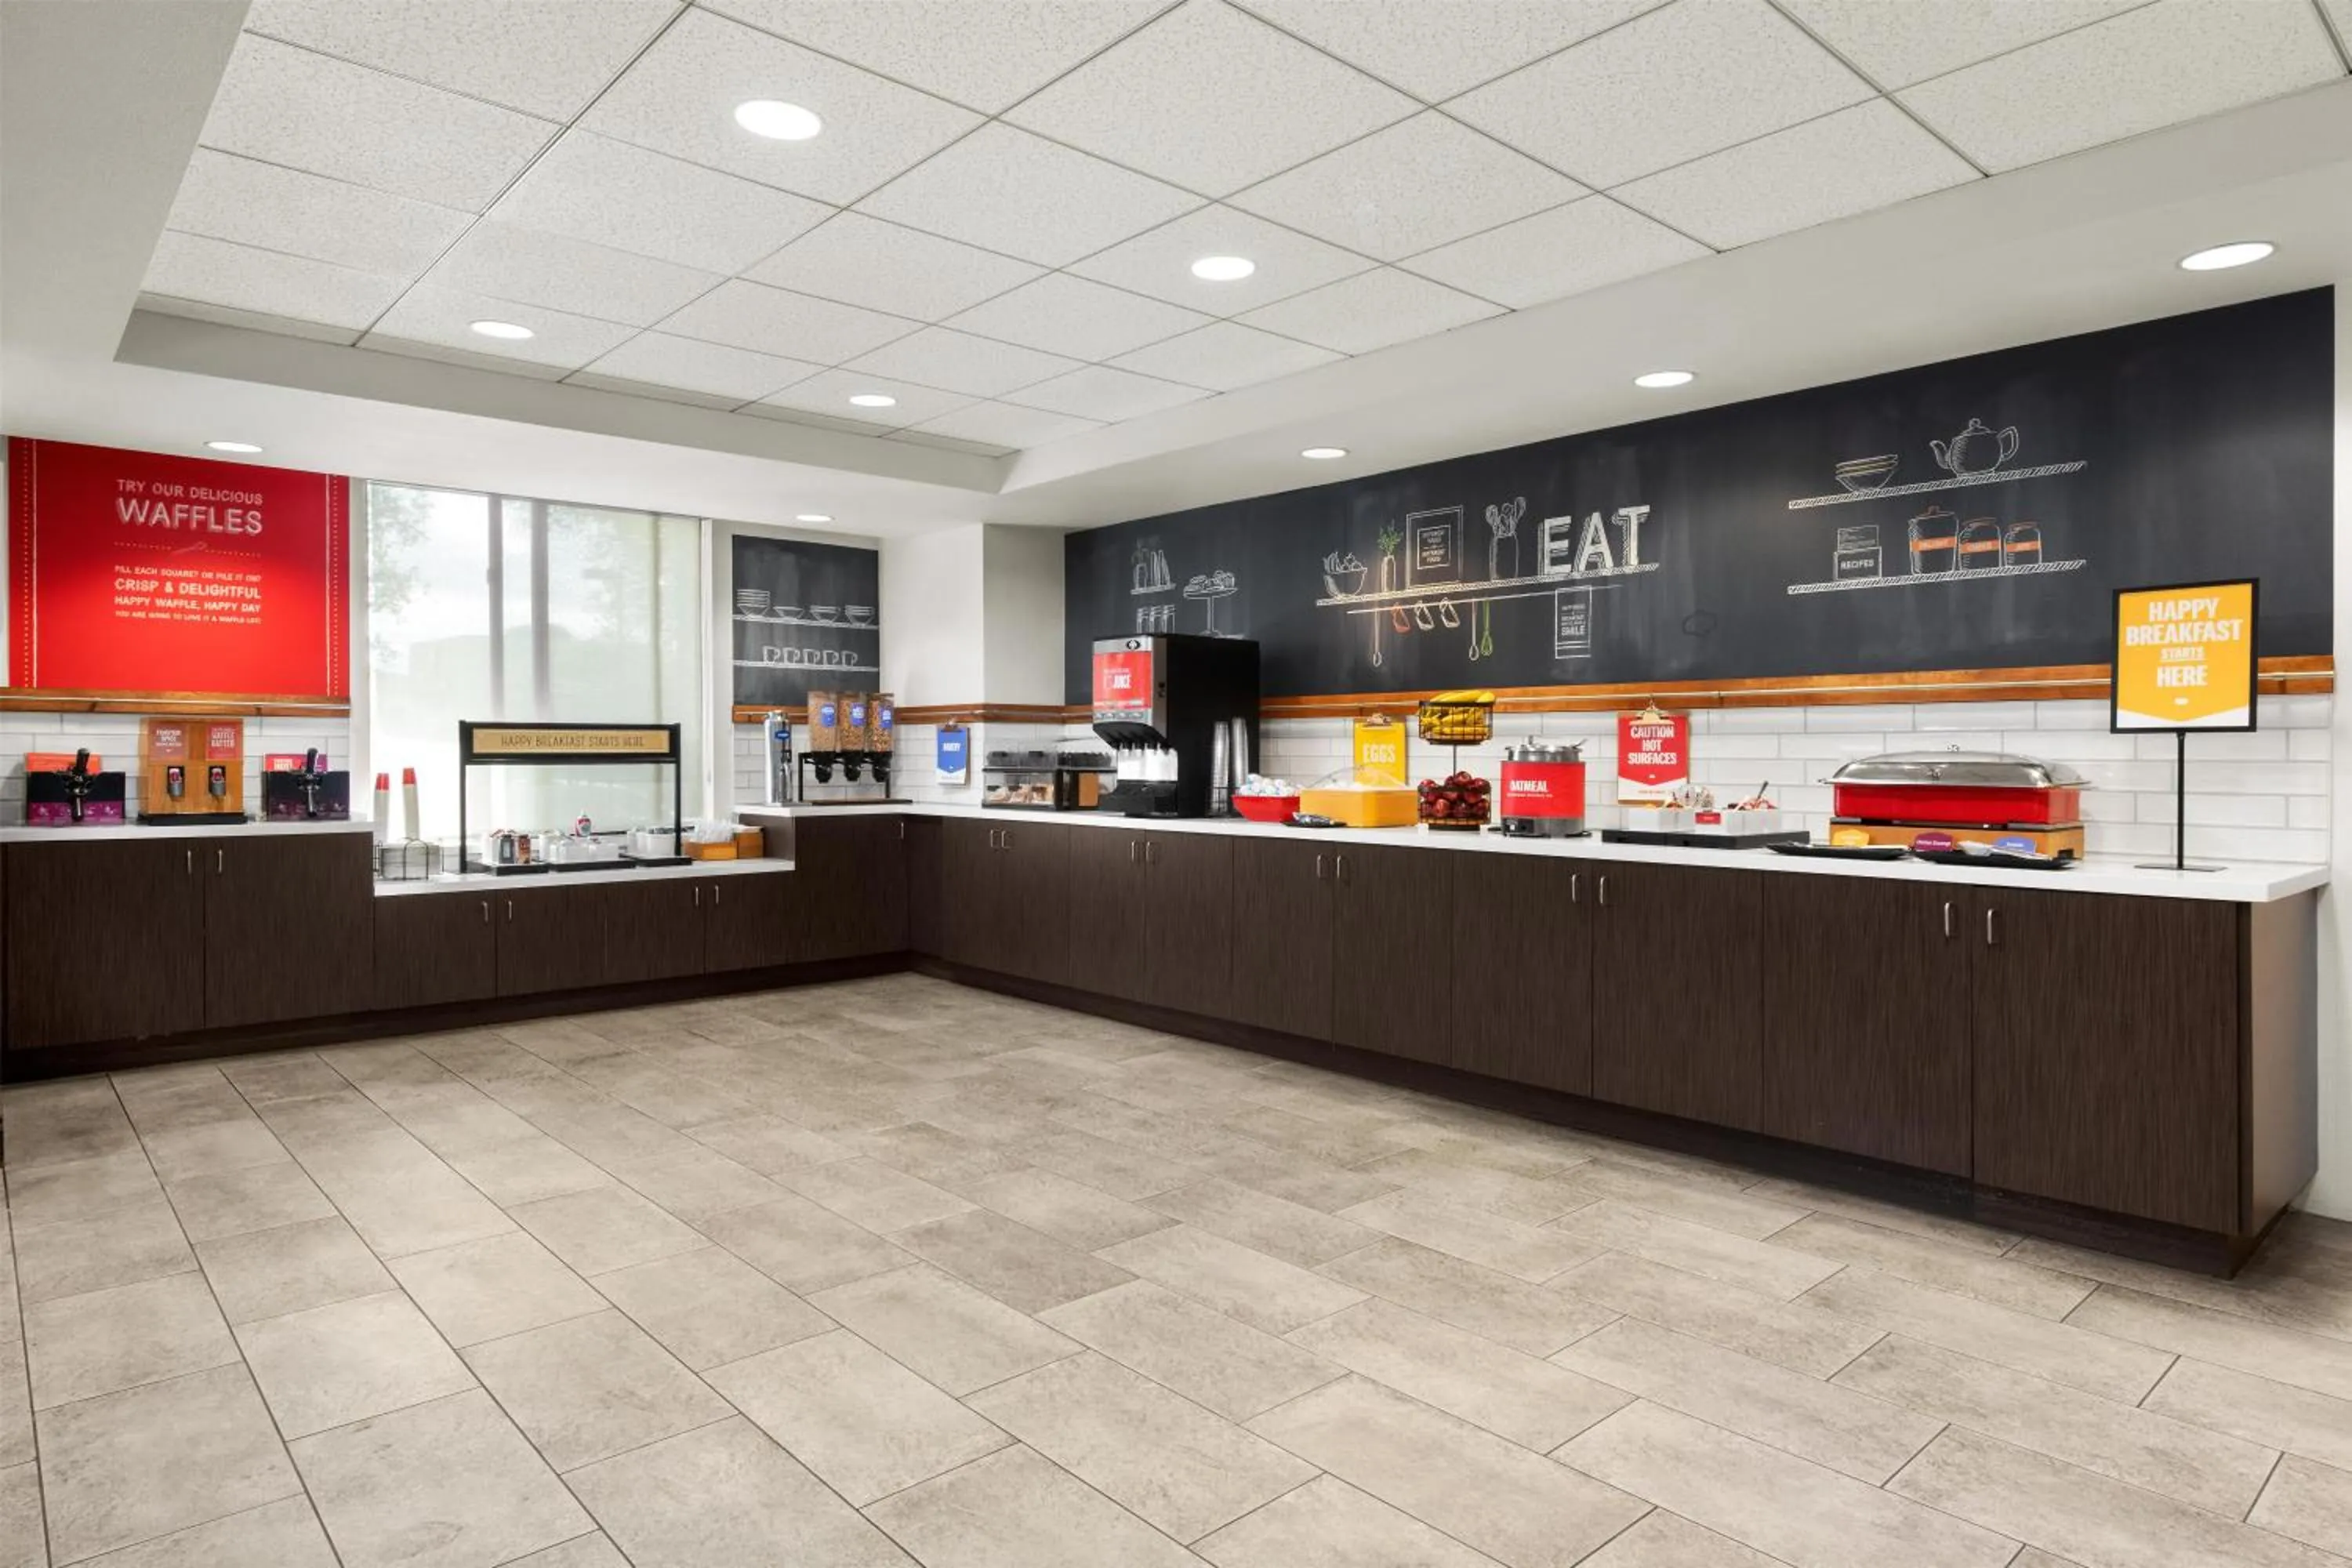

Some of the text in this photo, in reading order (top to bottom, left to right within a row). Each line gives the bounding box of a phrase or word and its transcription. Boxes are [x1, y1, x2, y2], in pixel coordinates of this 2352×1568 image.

[117, 479, 263, 506] TRY OUR DELICIOUS
[116, 497, 263, 536] WAFFLES
[1538, 505, 1650, 576] EAT
[114, 578, 261, 599] CRISP & DELIGHTFUL
[114, 596, 151, 606] HAPPY
[204, 601, 238, 612] HAPPY
[241, 603, 261, 612] DAY
[2149, 598, 2220, 622] HAPPY
[2126, 619, 2243, 646] BREAKFAST
[2161, 646, 2205, 660] STARTS
[2157, 665, 2209, 688] HERE
[501, 735, 532, 747] HAPPY
[536, 735, 585, 747] BREAKFAST
[589, 735, 619, 747] STARTS
[1631, 726, 1675, 739] CAUTION
[1363, 743, 1396, 764] EGGS
[1642, 740, 1661, 751] HOT
[1628, 753, 1677, 765] SURFACES
[1510, 780, 1548, 792] OATMEAL
